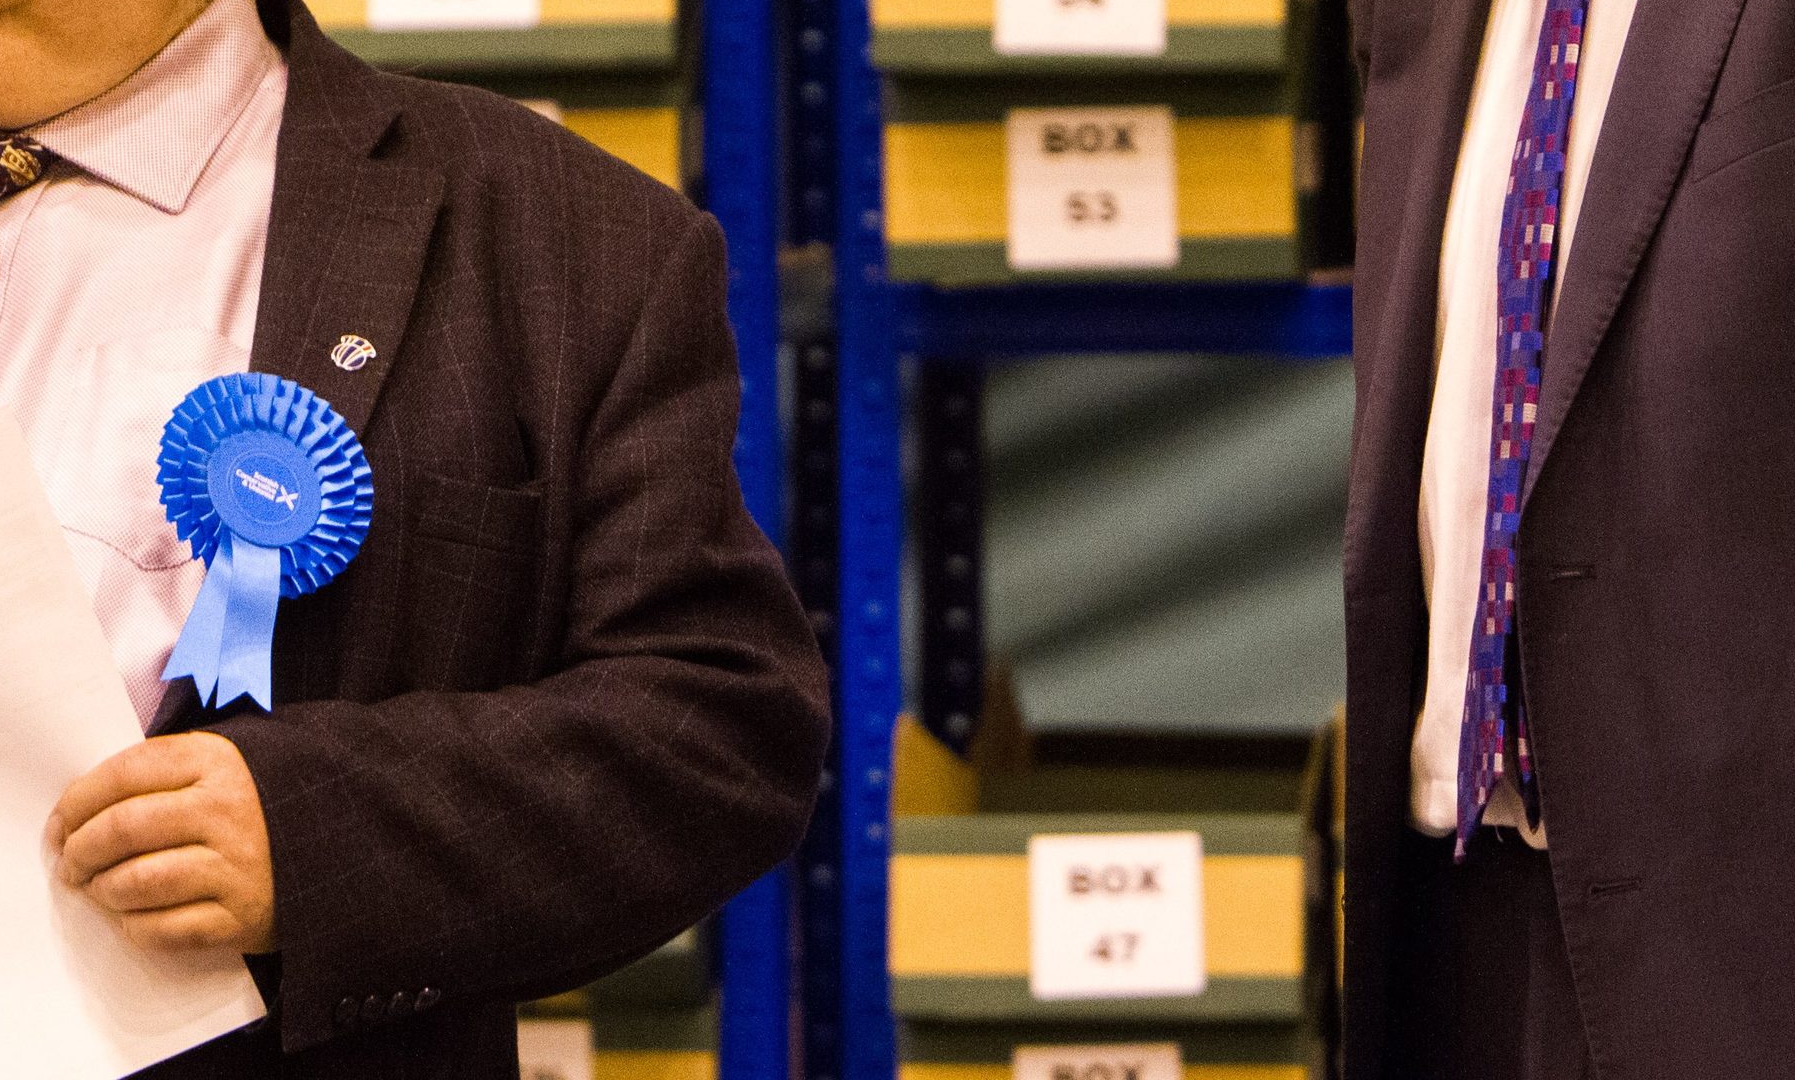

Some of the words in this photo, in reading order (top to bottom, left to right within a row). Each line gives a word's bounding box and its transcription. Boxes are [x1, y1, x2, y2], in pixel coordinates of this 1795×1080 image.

[1042, 123, 1136, 155] BOX
[1067, 865, 1160, 895] BOX
[1090, 932, 1140, 963] 47
